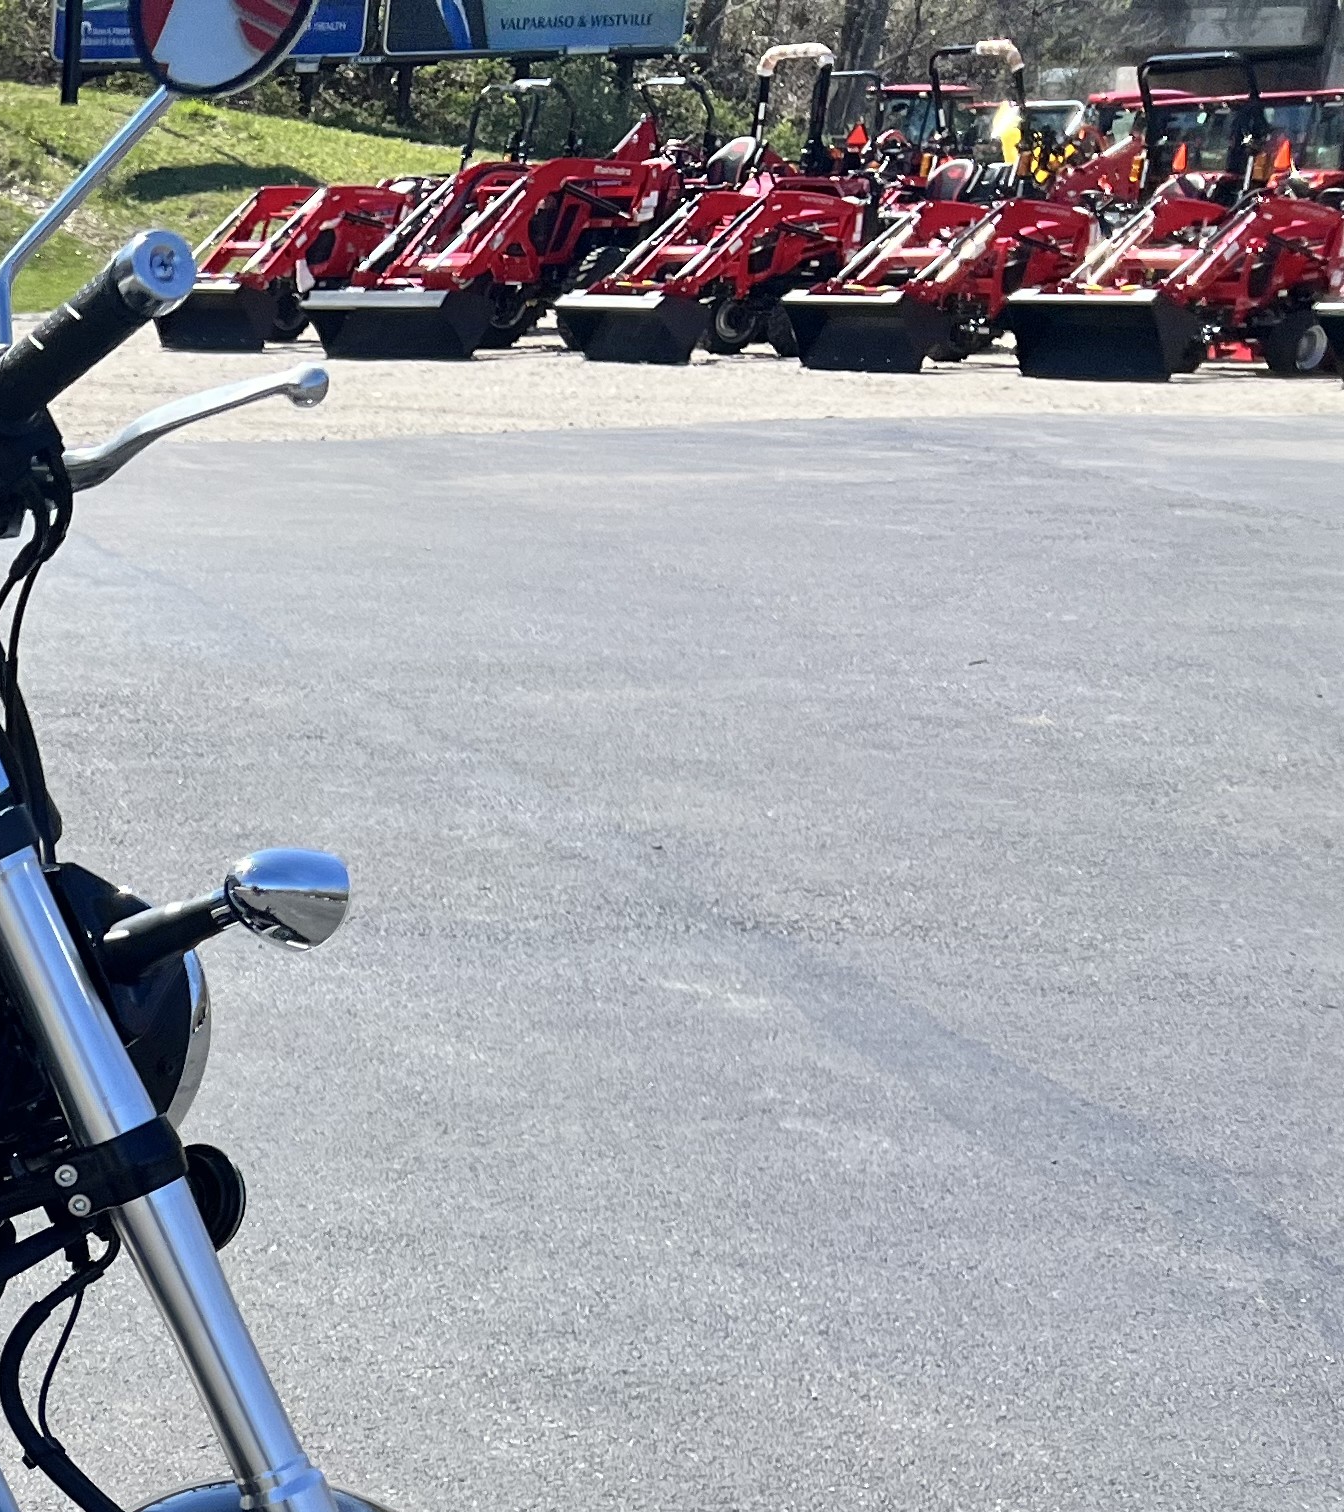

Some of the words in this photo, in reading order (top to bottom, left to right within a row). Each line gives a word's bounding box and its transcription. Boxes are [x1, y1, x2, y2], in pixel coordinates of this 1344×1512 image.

[500, 15, 574, 31] VALPARAISO
[577, 16, 587, 28] &
[590, 13, 654, 28] WESTVILLE
